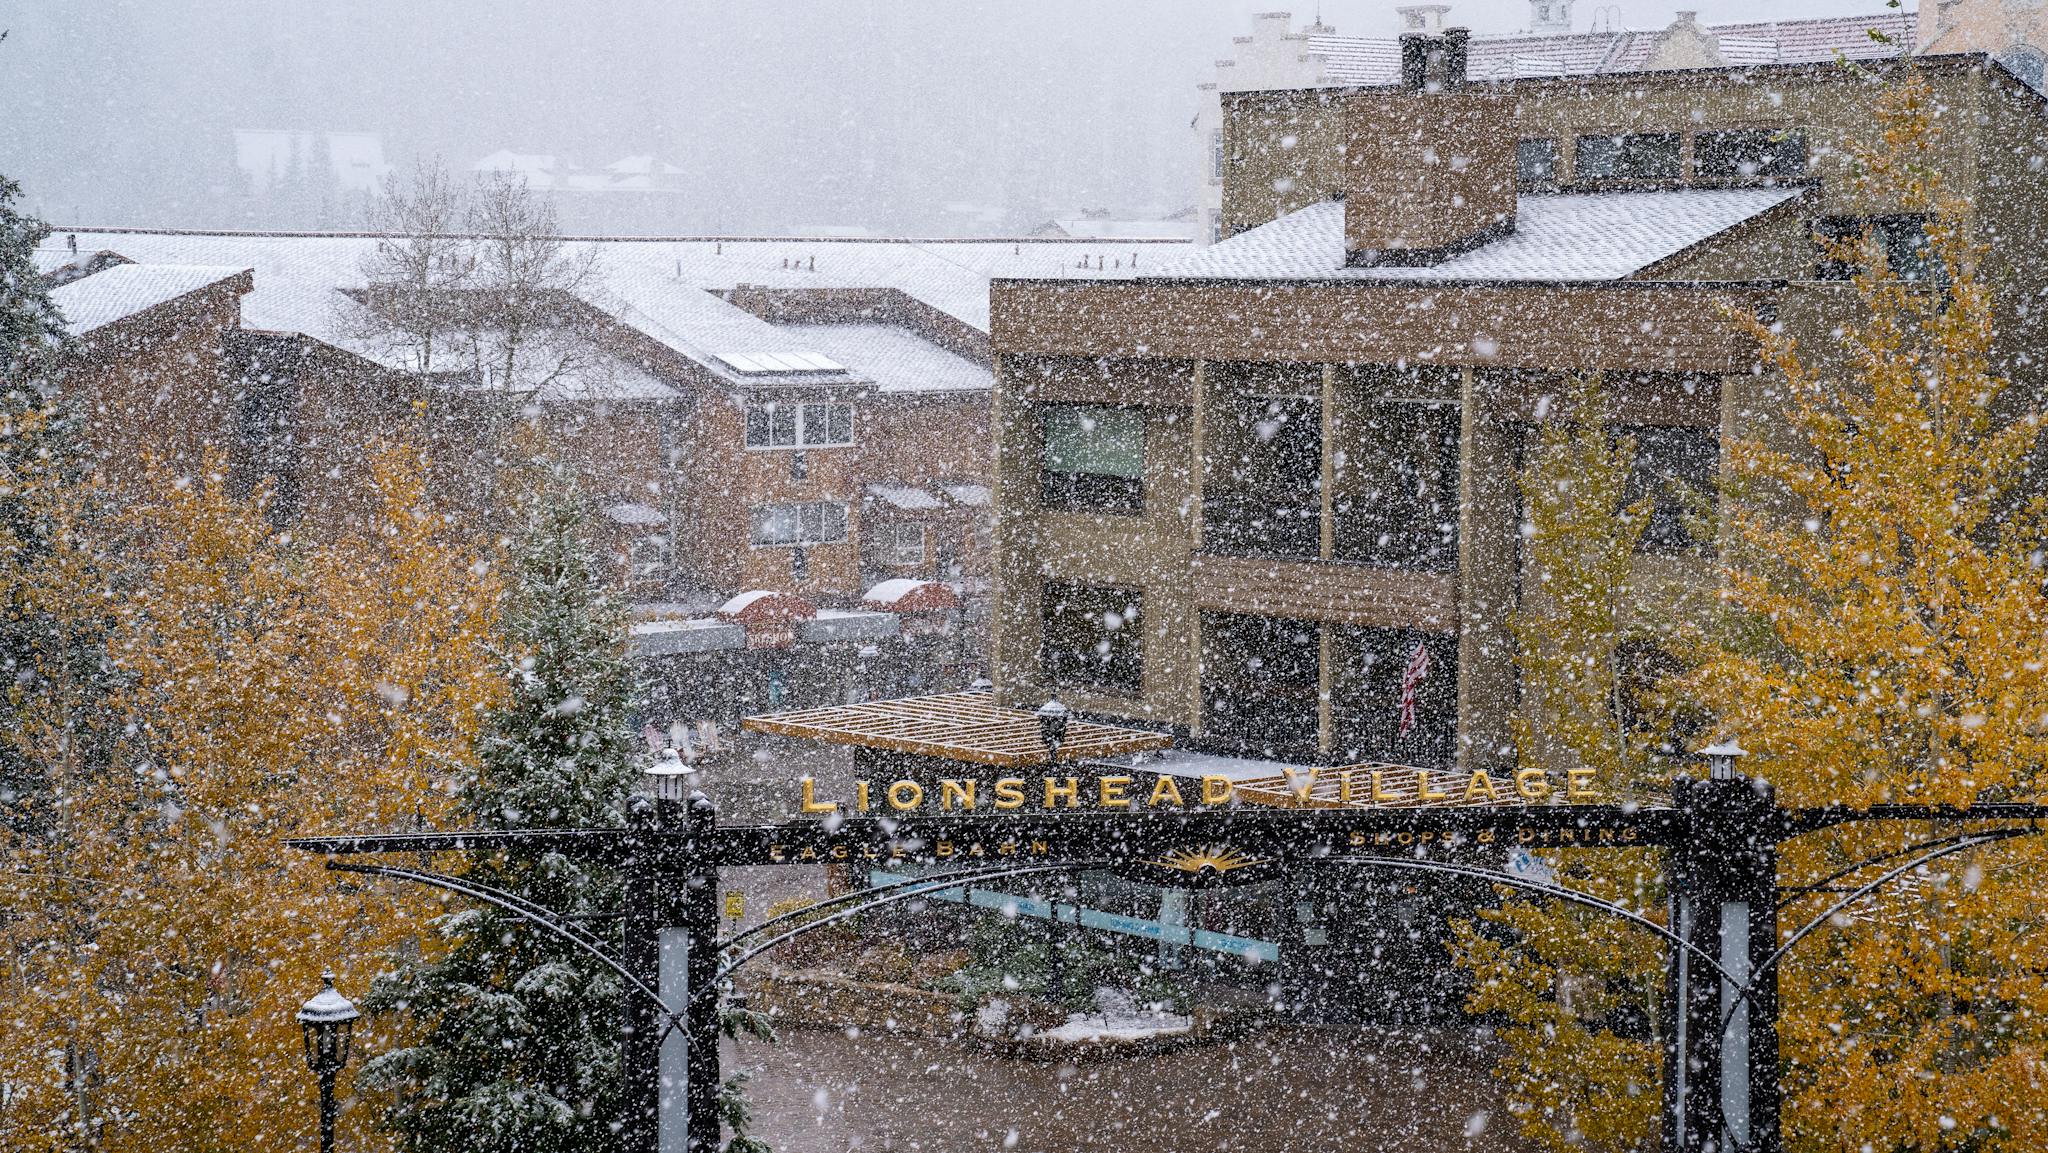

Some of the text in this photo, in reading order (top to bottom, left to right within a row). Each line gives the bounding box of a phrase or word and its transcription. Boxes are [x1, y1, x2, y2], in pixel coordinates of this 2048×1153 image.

[801, 767, 1597, 813] LIONSHEAD VILLAGE
[1349, 827, 1639, 846] SHOPS & DINING
[770, 840, 1048, 861] EAGLE BAHN
